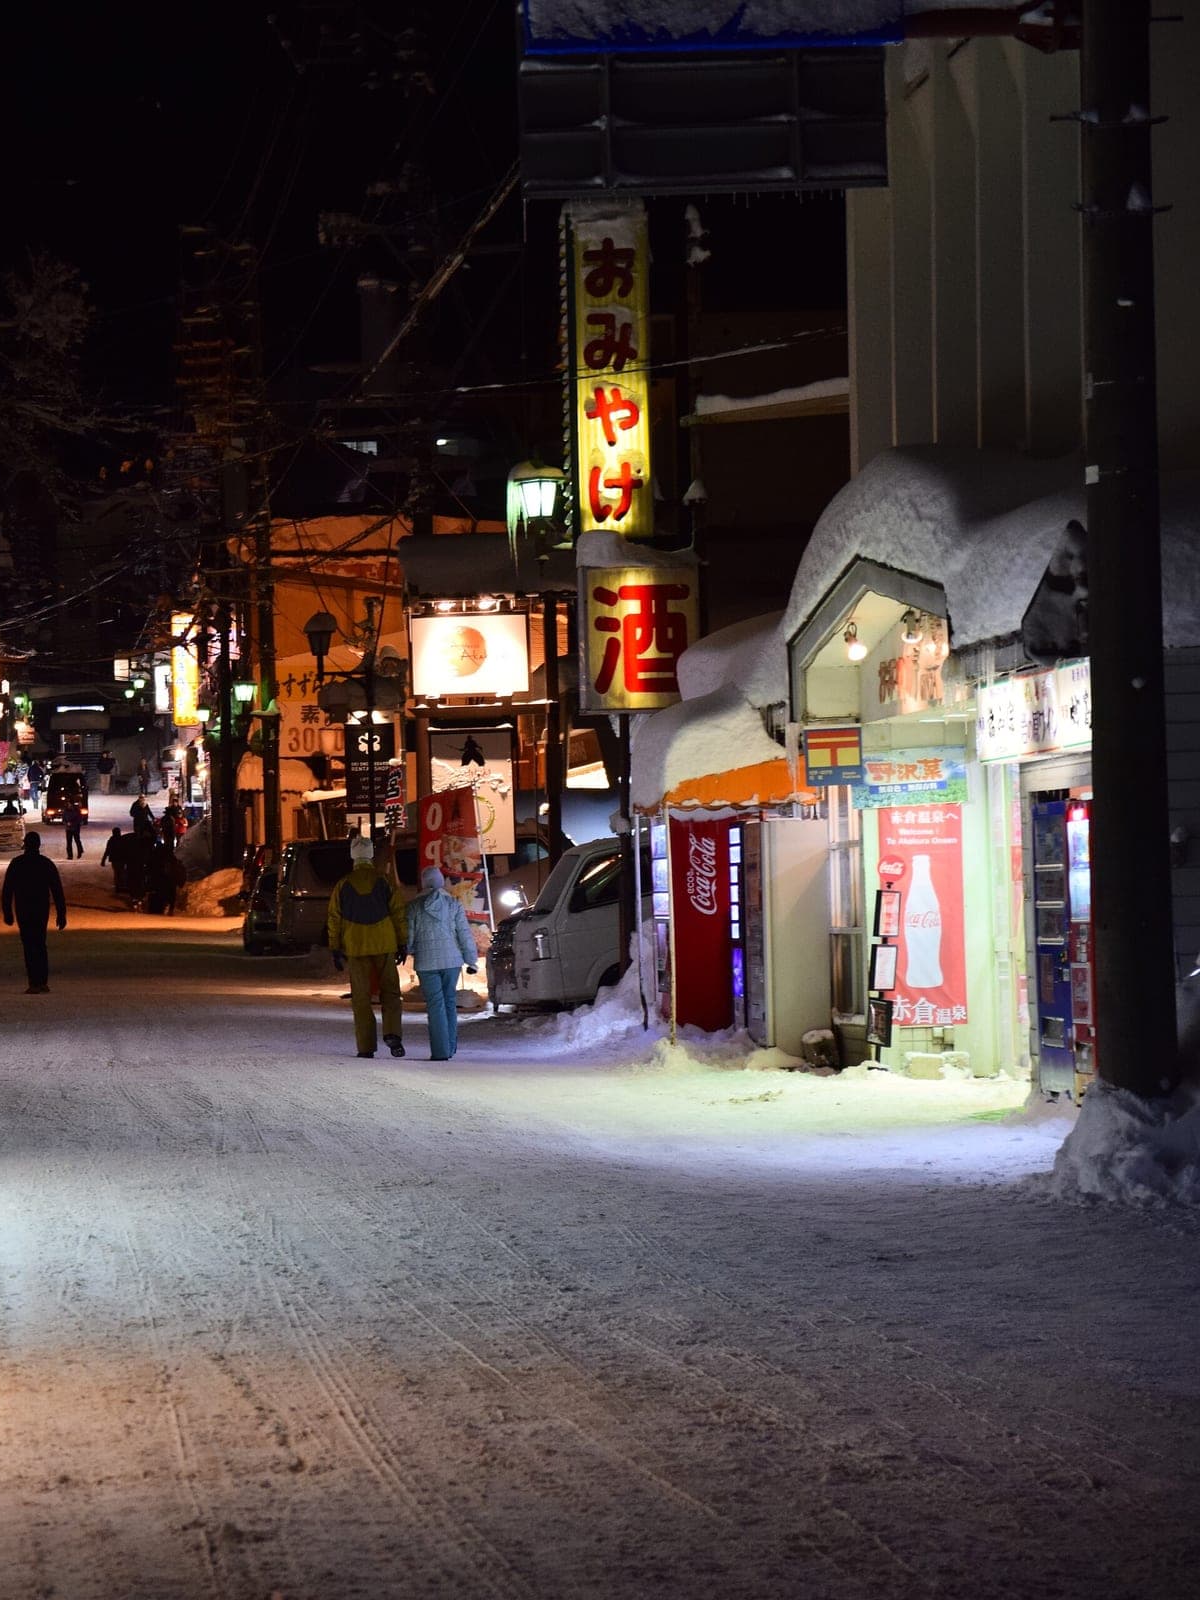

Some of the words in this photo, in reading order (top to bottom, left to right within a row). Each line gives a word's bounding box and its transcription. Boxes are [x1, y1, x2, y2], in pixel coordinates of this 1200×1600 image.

[593, 583, 689, 695] 酒
[866, 758, 945, 783] 野沢菜
[891, 809, 958, 825] 赤倉温泉へ
[886, 837, 897, 845] To
[689, 832, 718, 915] Coca-Cola
[892, 996, 967, 1024] 赤倉温泉
